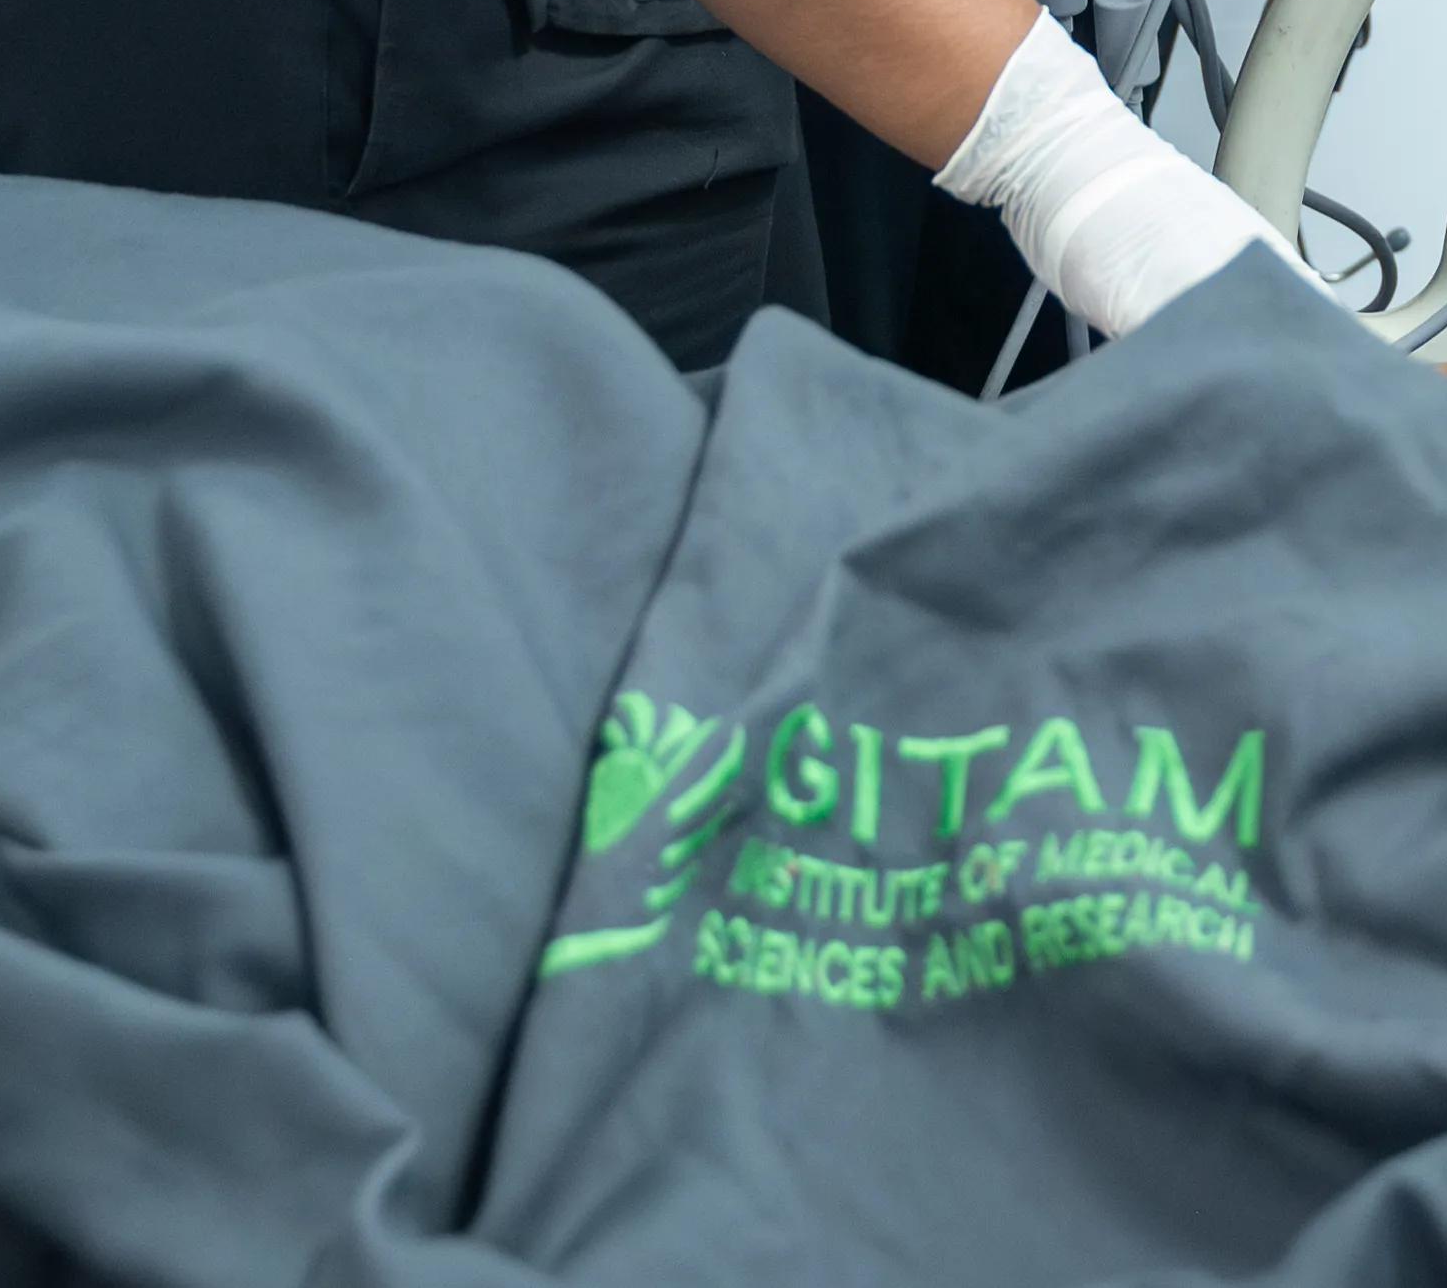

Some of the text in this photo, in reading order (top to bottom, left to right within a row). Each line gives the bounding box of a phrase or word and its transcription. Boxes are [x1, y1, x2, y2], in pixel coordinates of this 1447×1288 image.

[765, 701, 1266, 850] GITAM
[728, 827, 1262, 930] INSTITUTE OF MEDICAL
[692, 890, 1257, 1011] SCIENCES AND RESEARCH
